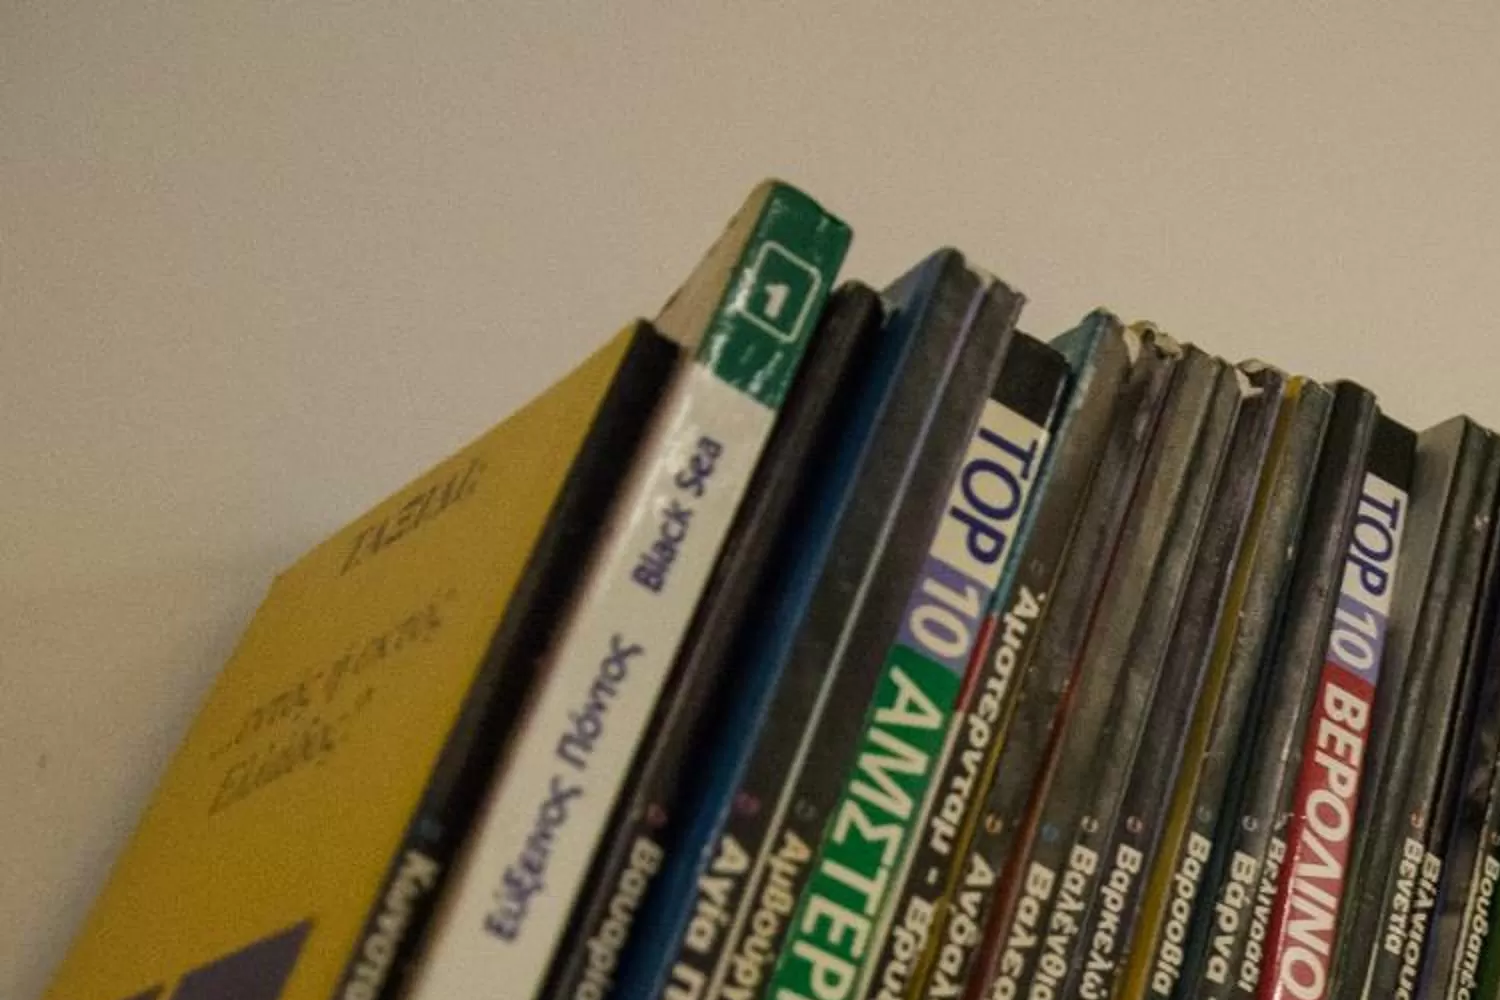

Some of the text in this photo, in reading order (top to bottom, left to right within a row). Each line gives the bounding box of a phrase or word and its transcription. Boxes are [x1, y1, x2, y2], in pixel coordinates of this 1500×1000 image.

[764, 282, 790, 318] 1
[631, 436, 725, 594] Black Sea
[950, 426, 1039, 566] TOP
[1344, 500, 1400, 607] TOP
[908, 577, 982, 659] 10
[1329, 611, 1379, 671] 10
[556, 633, 644, 772] Πόντος
[929, 585, 1046, 856] Άμστερνταμ
[685, 831, 749, 954] Αγία
[1151, 831, 1212, 996] Βαρσοβία
[1204, 850, 1259, 988] Βάρνα
[1384, 837, 1424, 956] Βενετία
